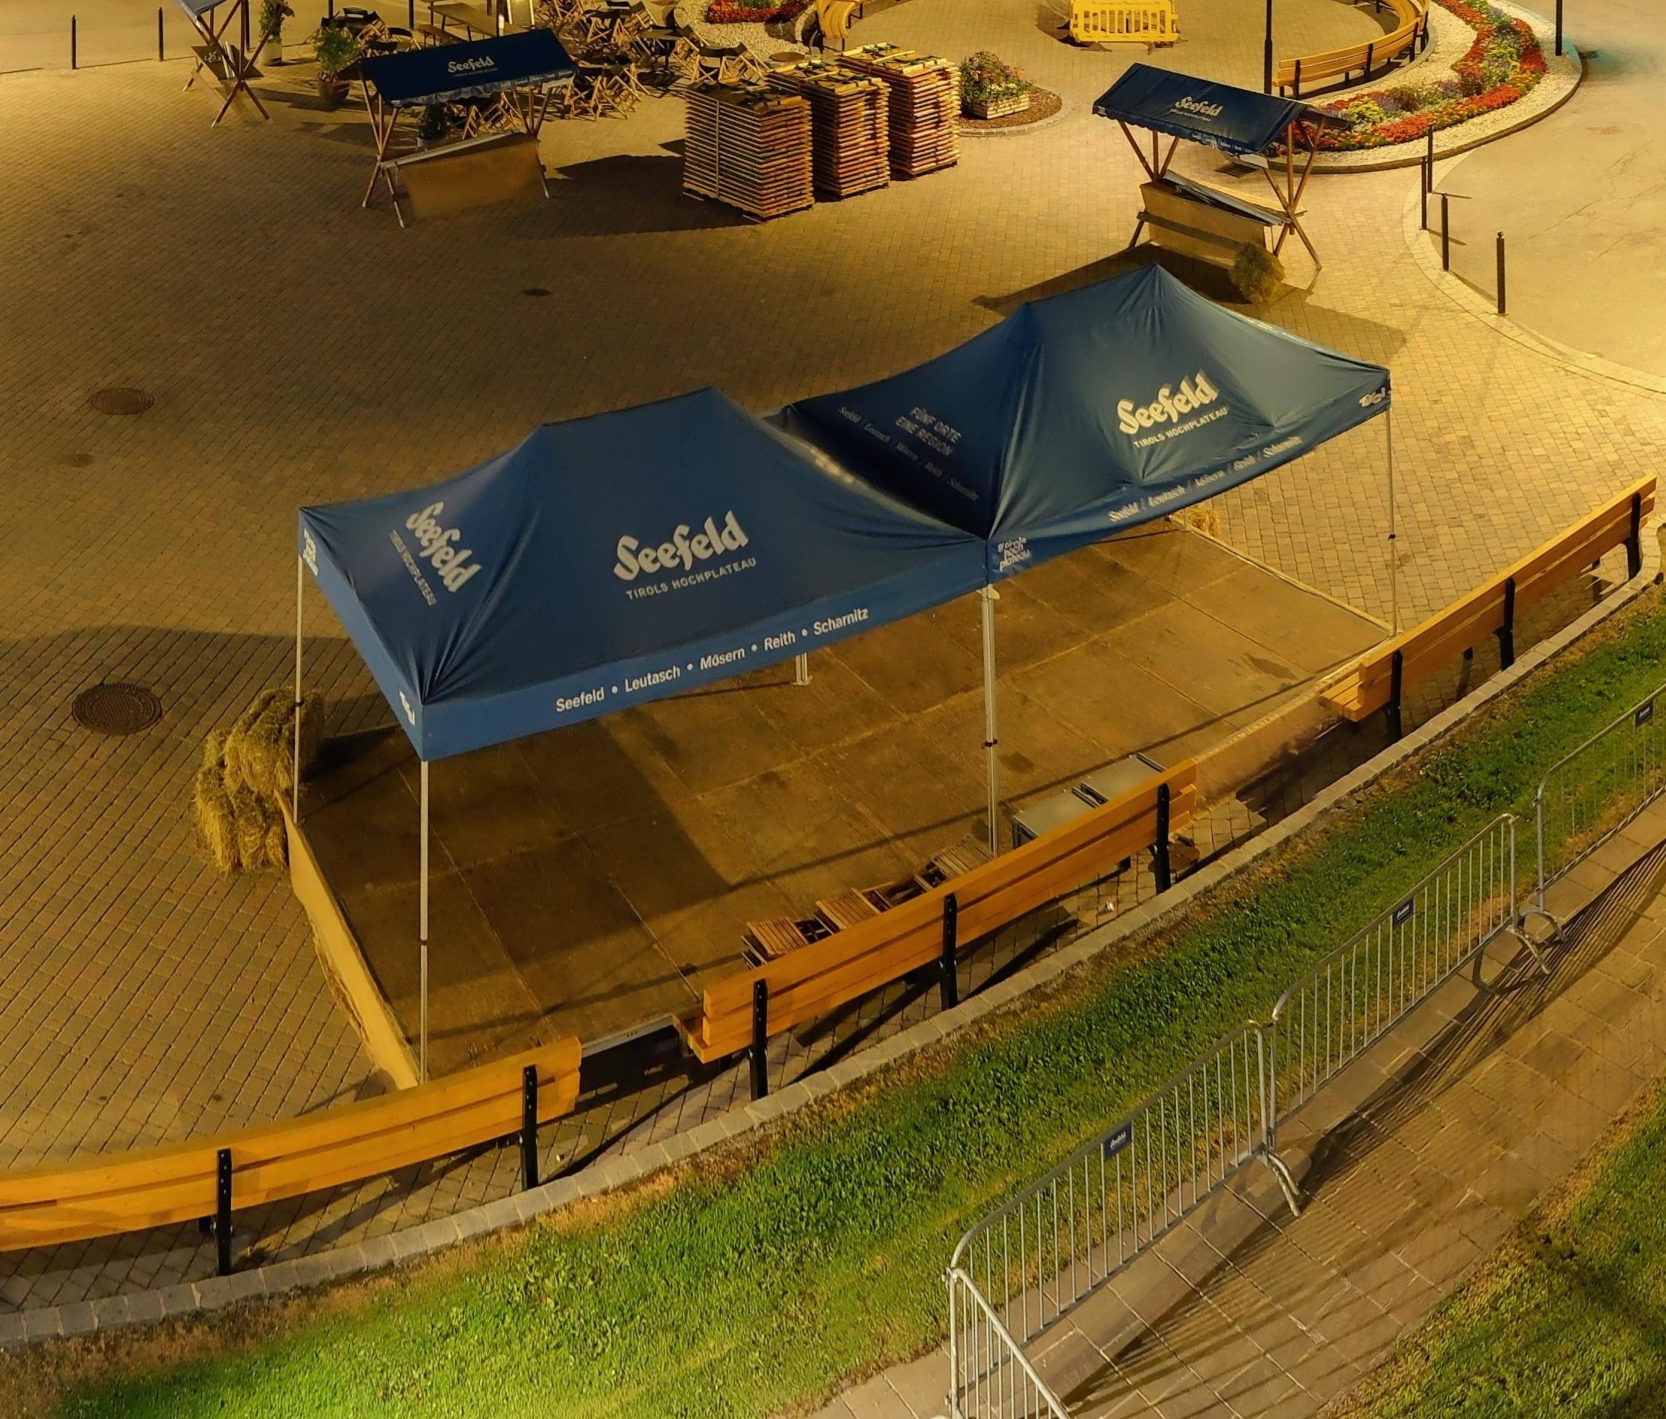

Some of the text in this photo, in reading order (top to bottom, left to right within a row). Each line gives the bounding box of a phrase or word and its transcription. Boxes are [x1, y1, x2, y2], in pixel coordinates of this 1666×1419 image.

[447, 55, 495, 74] Seefeld
[1174, 95, 1224, 118] Seefeld
[1116, 369, 1219, 436] Seefeld
[1133, 405, 1229, 449] TIROLS HOCHPLATEAU
[405, 500, 483, 594] Seefeld
[612, 509, 750, 582] Seefeld
[625, 556, 758, 601] TIROLS HOCHPLATEAU
[555, 606, 870, 713] Seefeld Leutasch Mösern Reith Scharnitz
